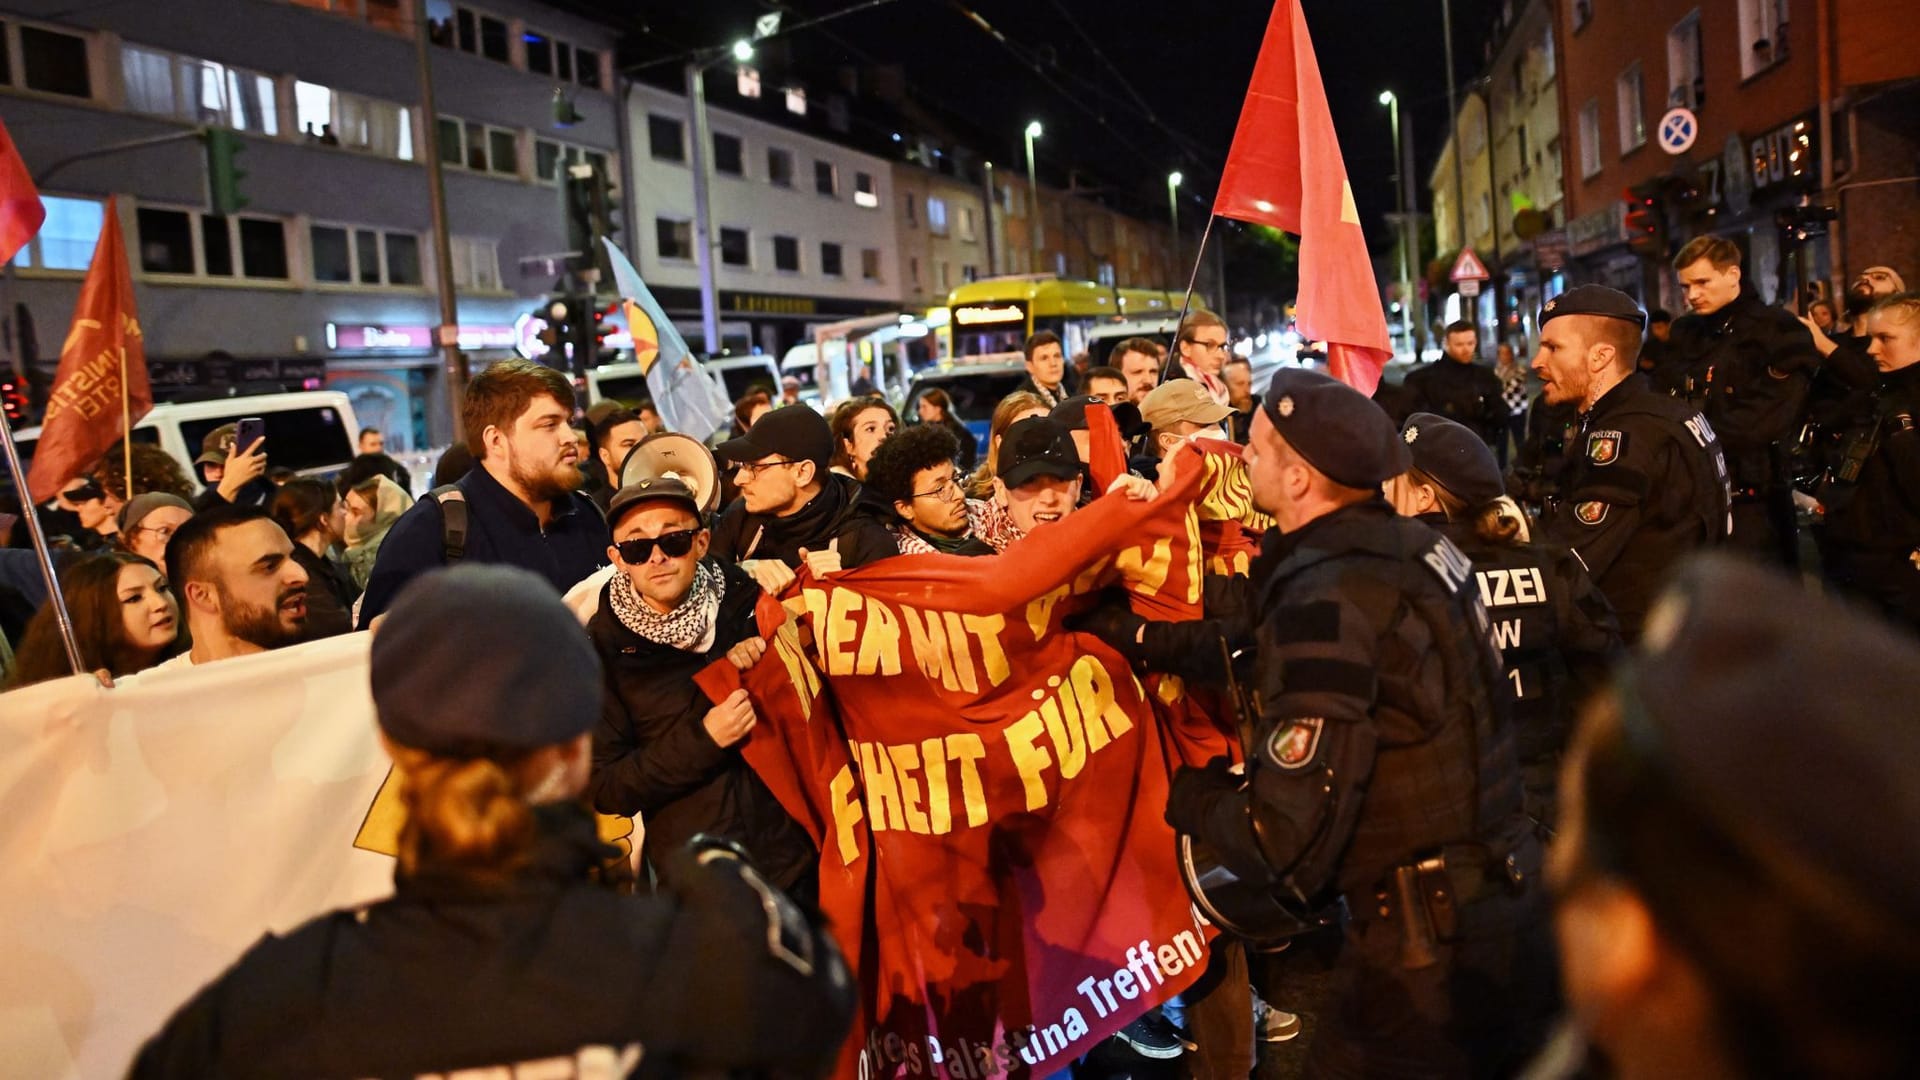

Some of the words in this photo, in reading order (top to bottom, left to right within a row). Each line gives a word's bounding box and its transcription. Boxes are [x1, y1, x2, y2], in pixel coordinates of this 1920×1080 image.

[1590, 430, 1621, 439] POLIZEI
[1475, 567, 1547, 607] IZEI
[900, 604, 1011, 695] MIT
[830, 732, 989, 866] FHEIT
[1003, 654, 1134, 812] FÜR
[924, 1006, 1088, 1080] Palästina
[1077, 929, 1203, 1018] Treffen
